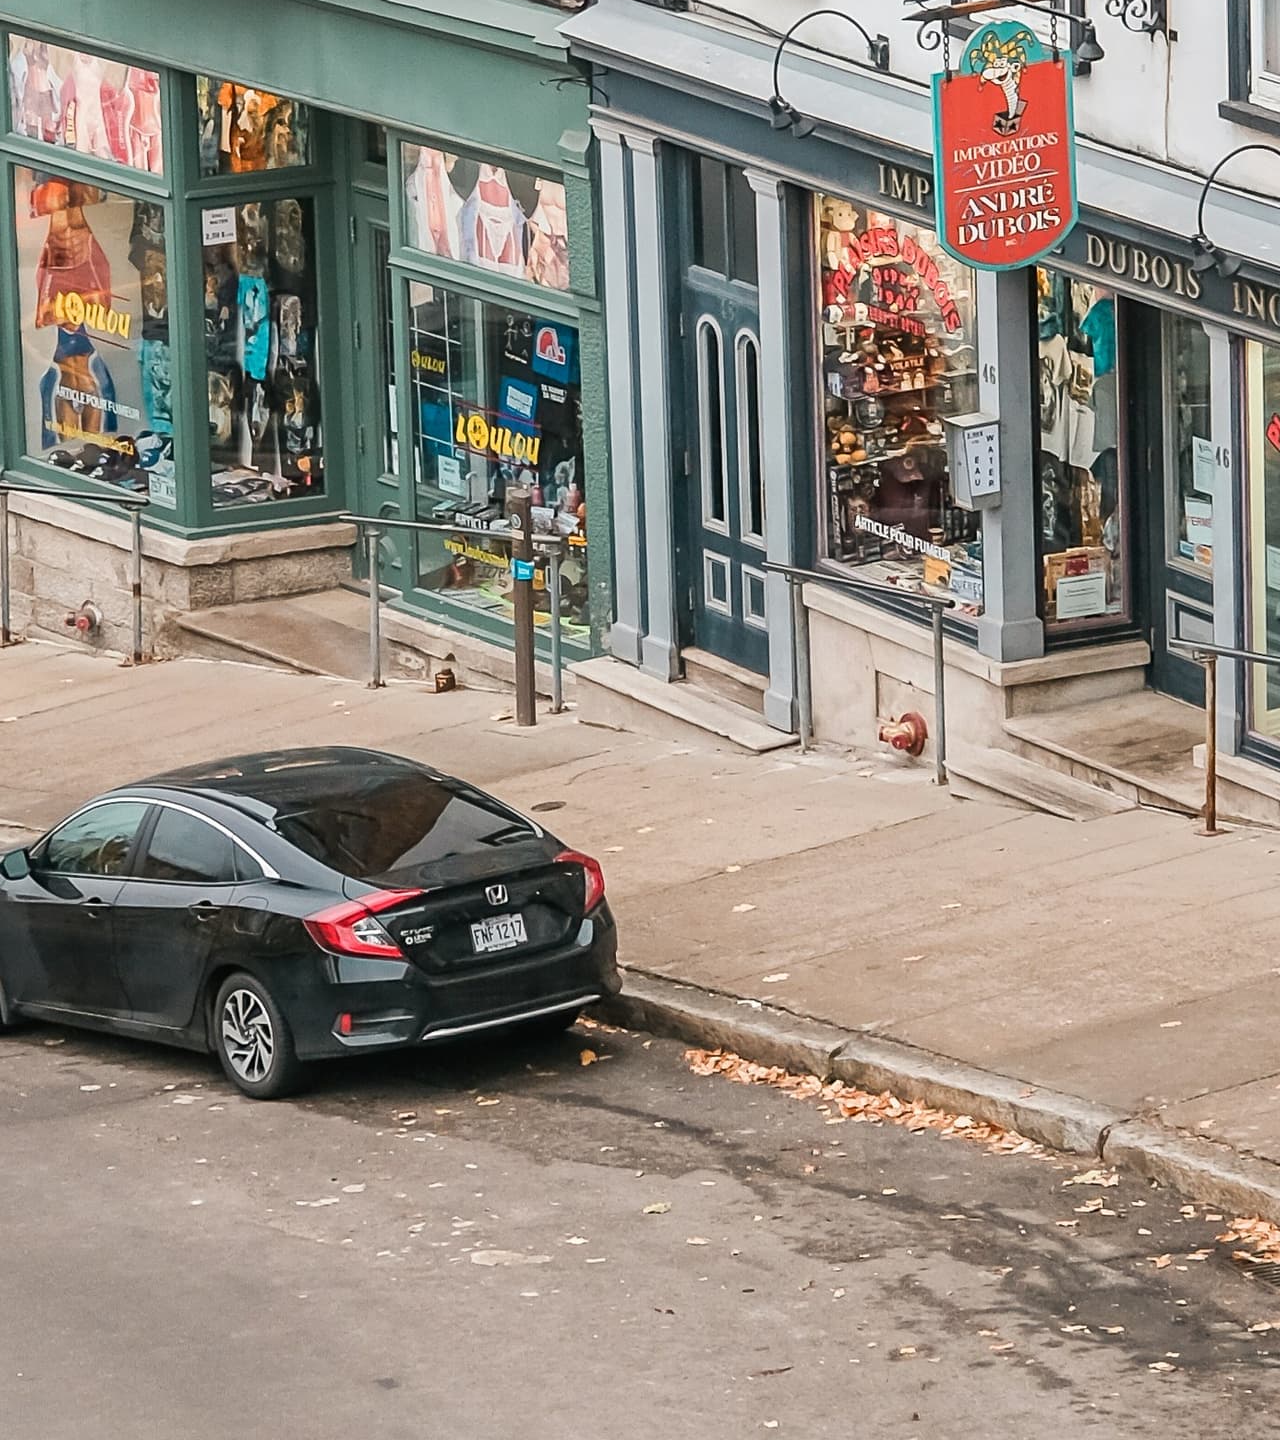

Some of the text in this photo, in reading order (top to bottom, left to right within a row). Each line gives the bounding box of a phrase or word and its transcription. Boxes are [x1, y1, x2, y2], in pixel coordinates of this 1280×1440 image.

[953, 131, 1060, 163] IMPORTATIONS
[973, 150, 1042, 183] VIDÉO
[961, 178, 1057, 220] ANDRÉ
[958, 207, 1062, 246] DUBOIS
[1086, 232, 1202, 300] DUBOIS
[974, 455, 982, 487] EAU
[986, 434, 995, 487] WATER
[854, 514, 889, 540] ARTICLE
[889, 526, 914, 549] POUR
